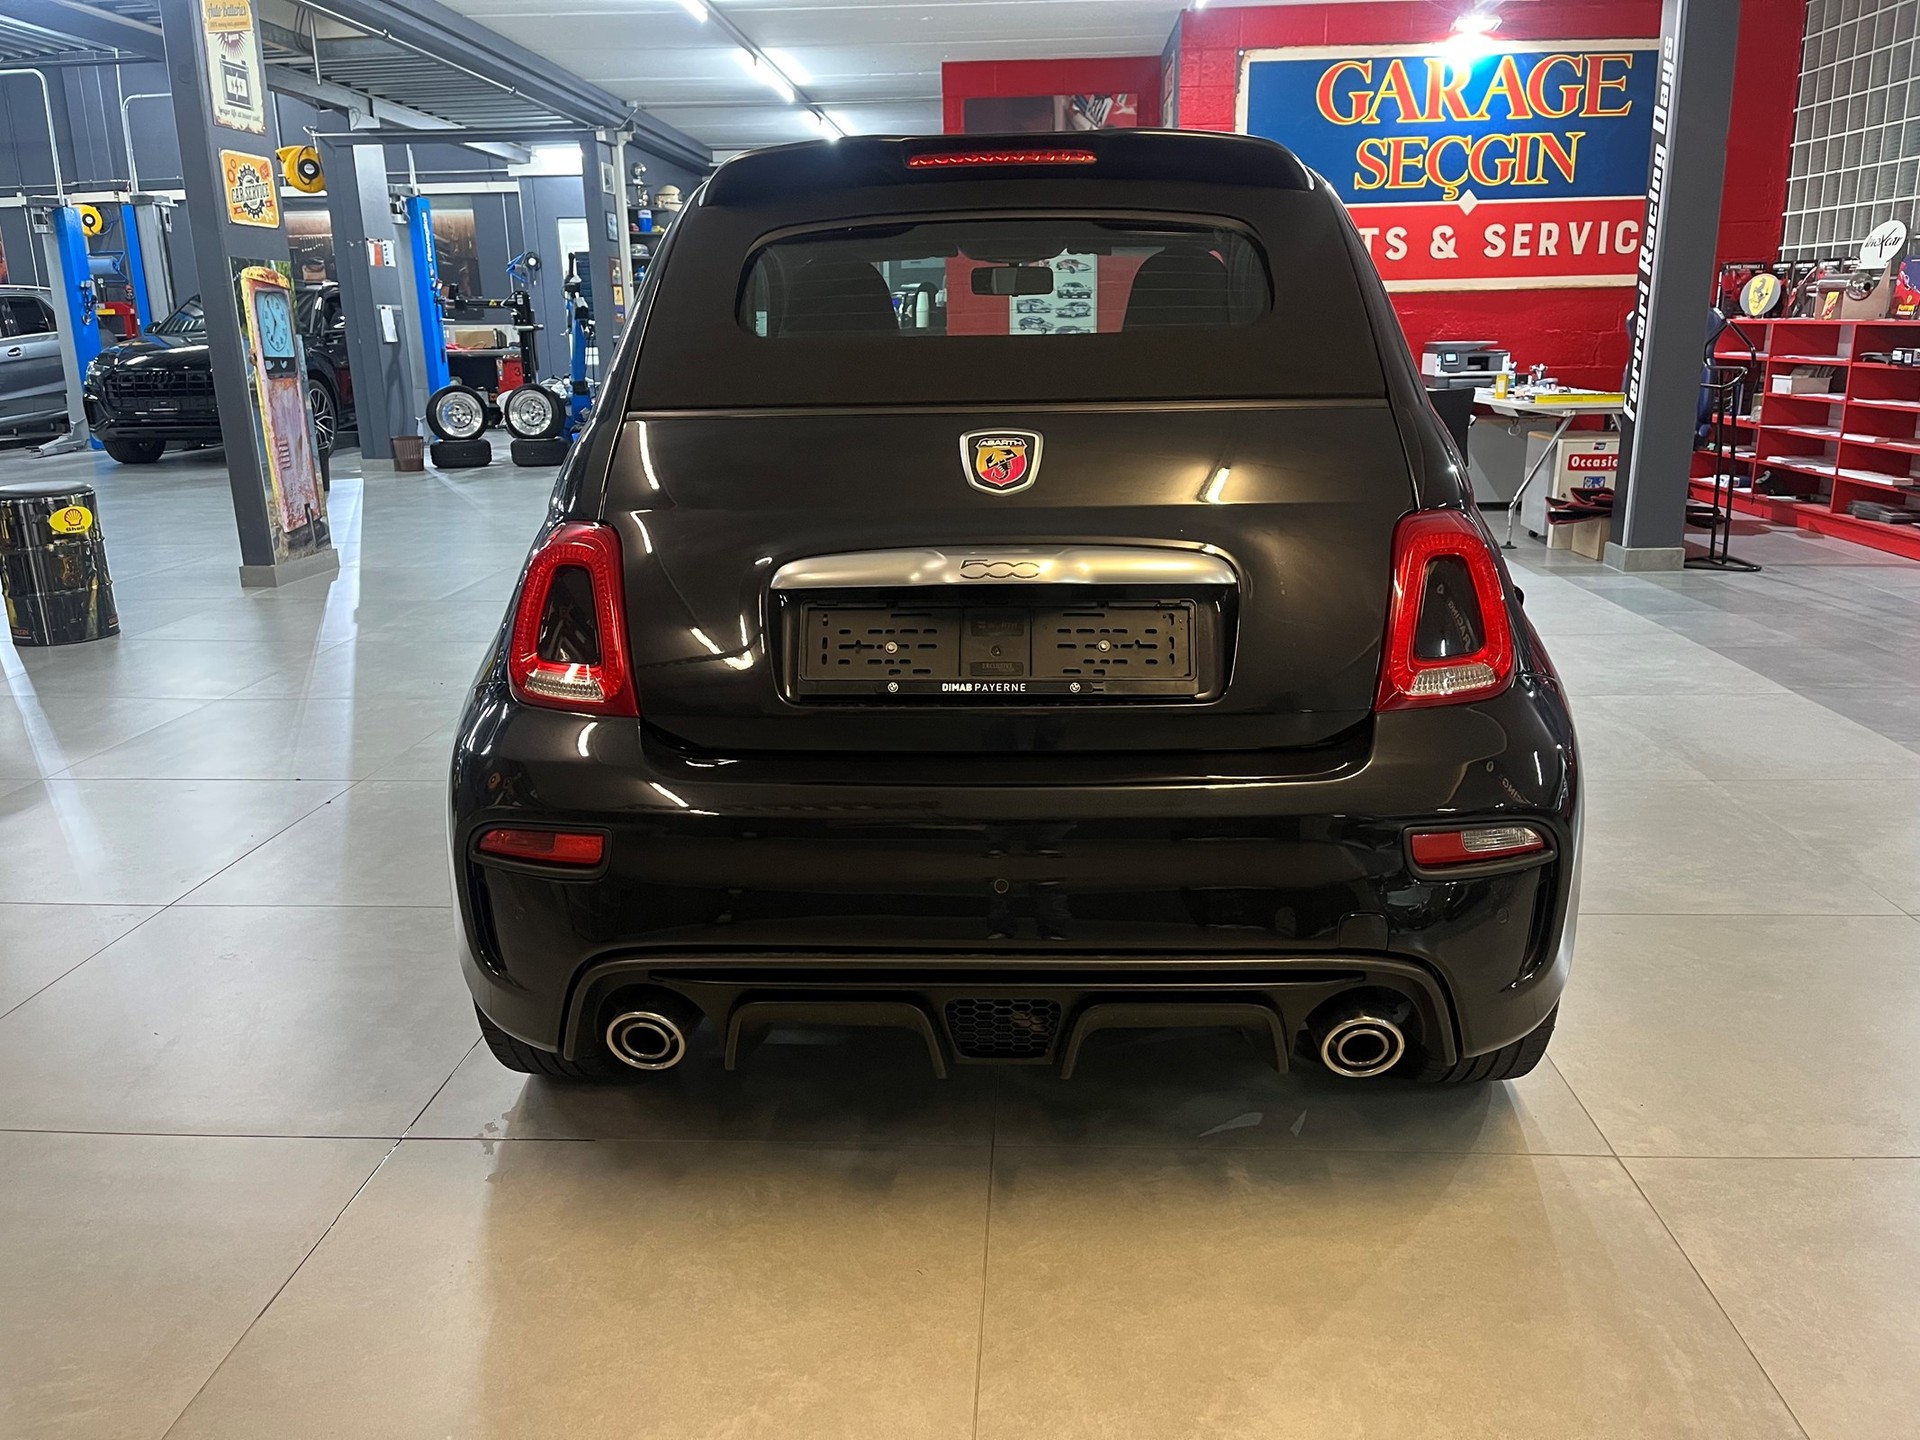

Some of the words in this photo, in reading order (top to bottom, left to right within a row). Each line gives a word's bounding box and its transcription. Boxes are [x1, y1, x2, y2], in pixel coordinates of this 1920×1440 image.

[1316, 53, 1633, 125] GARAGE
[1354, 131, 1586, 200] SEÇGIN
[231, 186, 245, 204] CAR
[245, 182, 270, 201] SERVICE
[1358, 226, 1408, 260] TS
[1430, 225, 1459, 259] &
[1483, 220, 1640, 259] SERVIC
[1623, 280, 1649, 421] Ferrari
[1638, 143, 1666, 276] Racing
[1653, 36, 1675, 135] Days
[1570, 455, 1618, 468] Occasio
[960, 559, 1041, 579] 500
[942, 683, 972, 692] DIMAB
[974, 683, 1026, 692] PAYERNE
